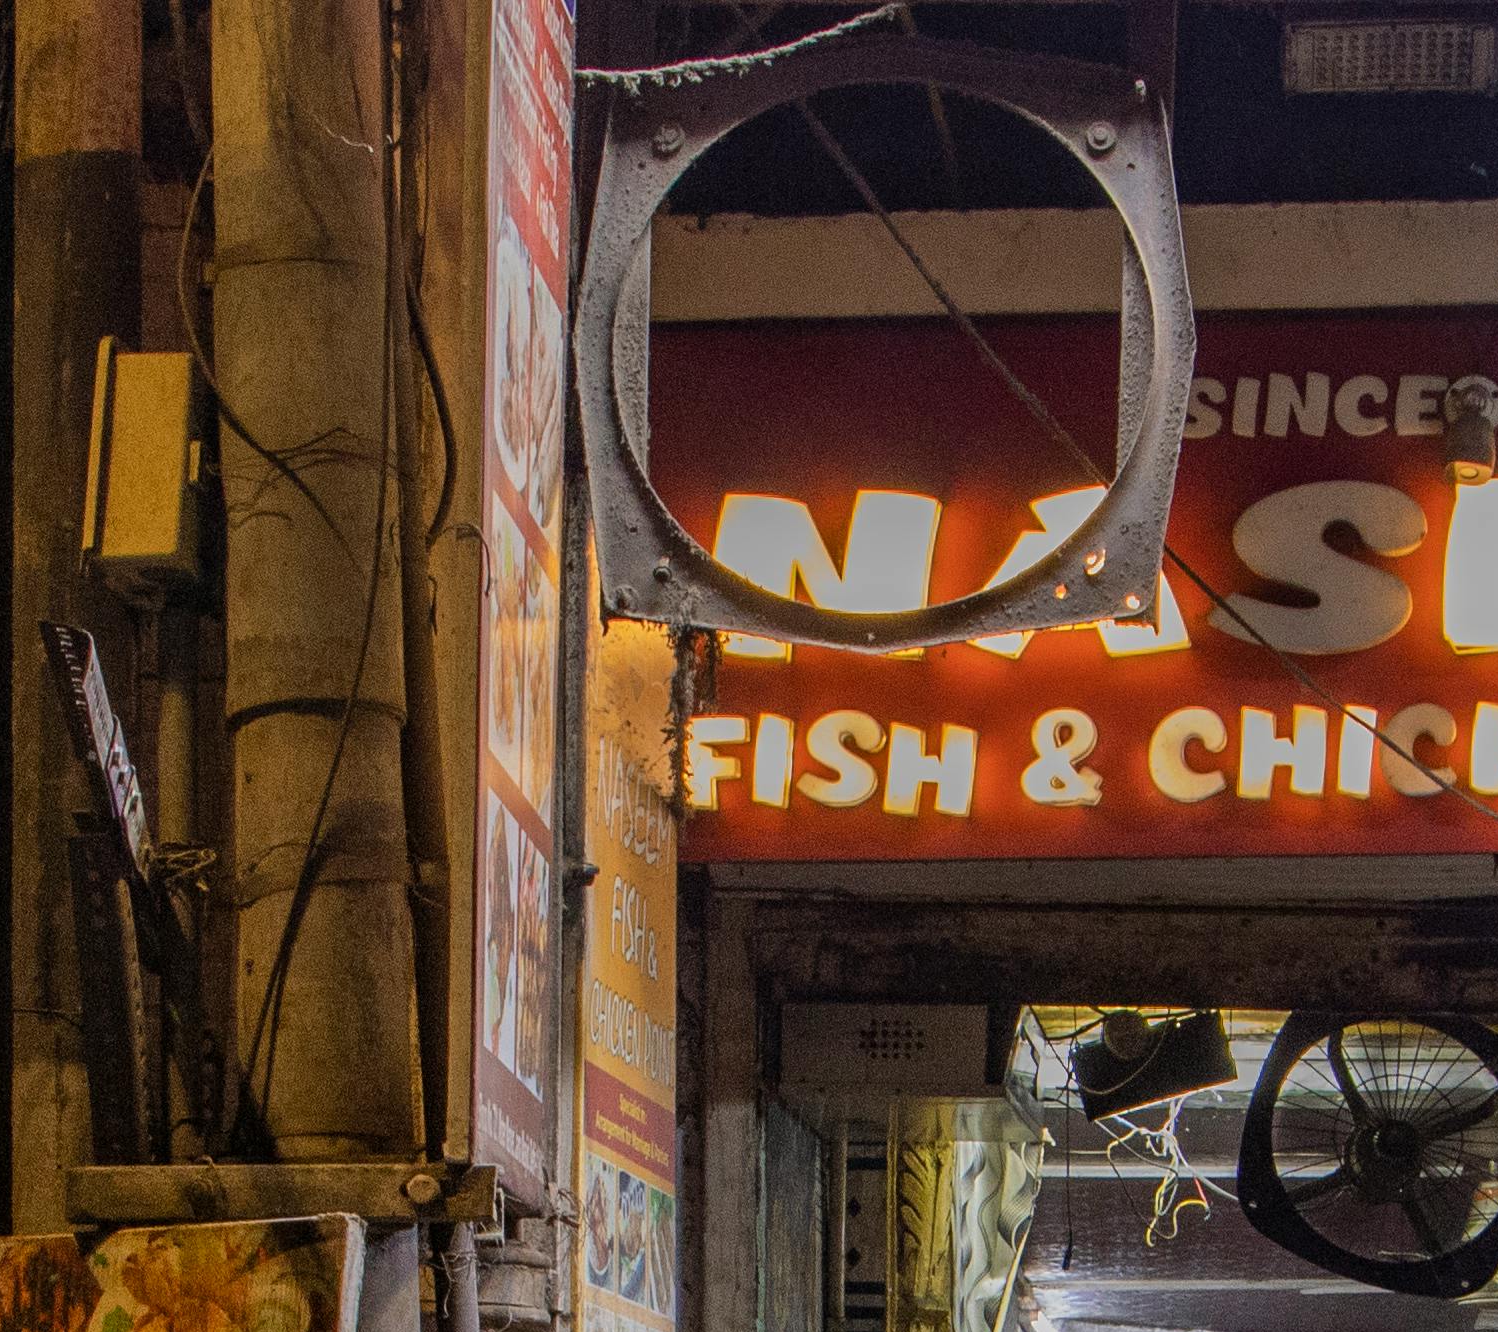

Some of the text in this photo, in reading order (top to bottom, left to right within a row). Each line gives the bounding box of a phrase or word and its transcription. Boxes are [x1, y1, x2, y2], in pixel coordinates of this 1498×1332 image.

[1182, 372, 1445, 439] SINCE
[595, 735, 672, 872] NASEEM
[687, 709, 978, 817] FISH
[1021, 707, 1103, 807] &
[610, 874, 658, 981] FISH &
[590, 978, 641, 1075] CHICKEN
